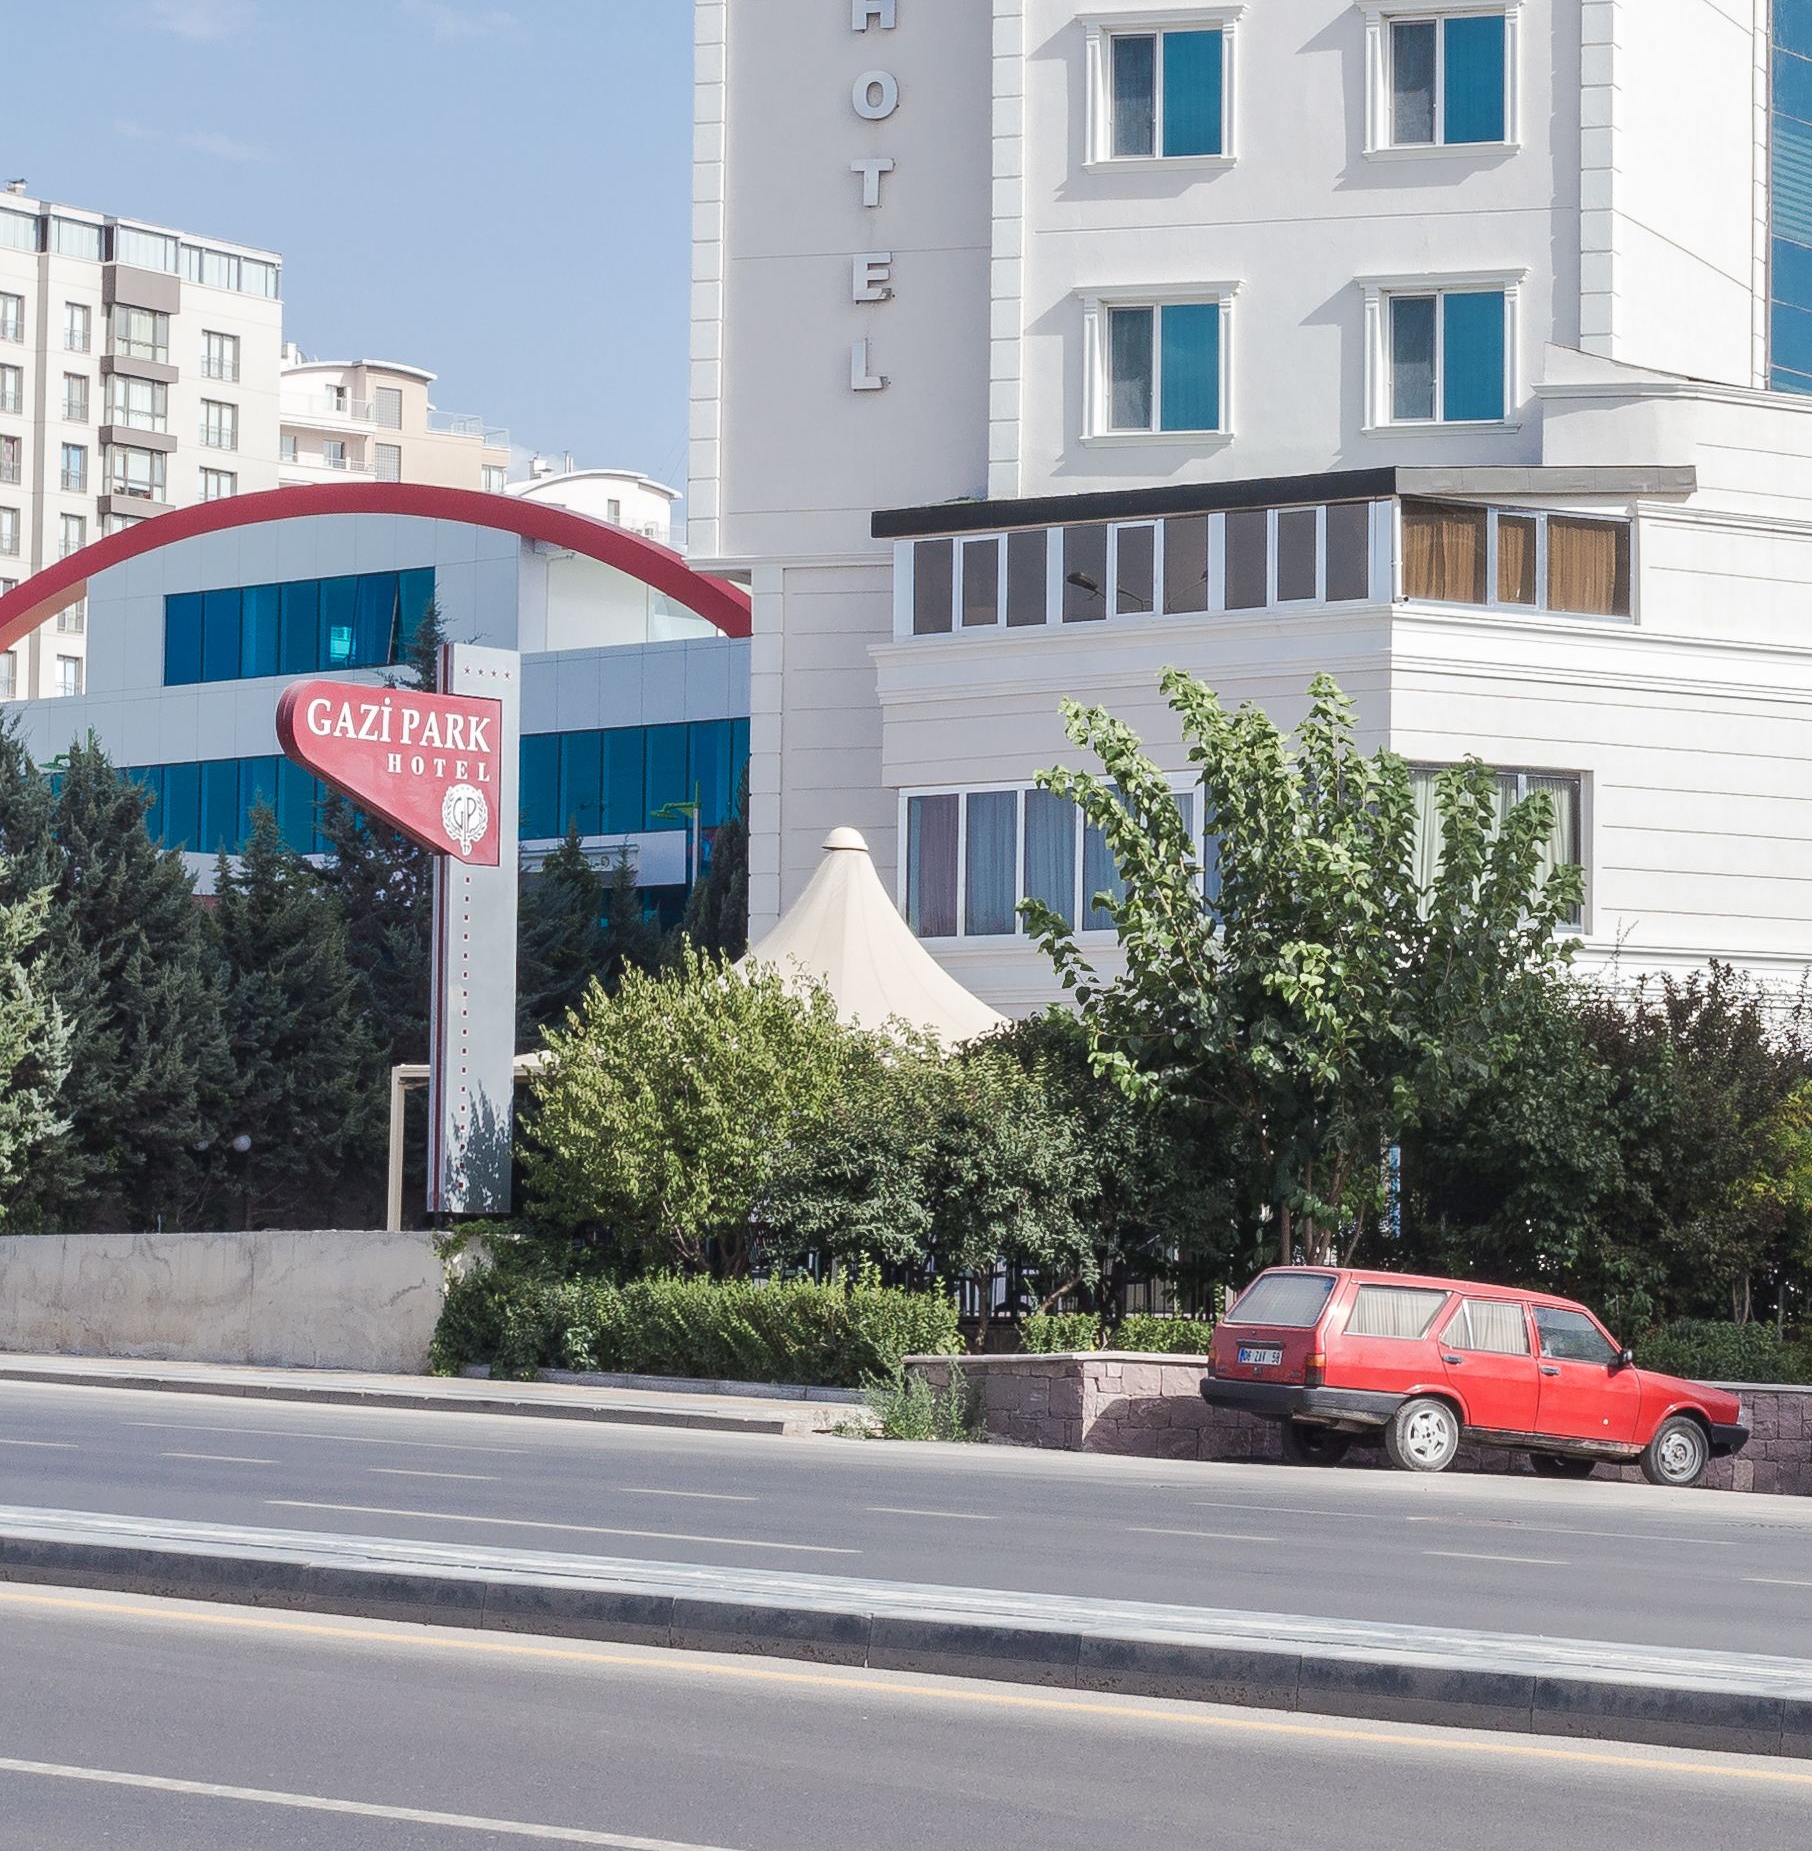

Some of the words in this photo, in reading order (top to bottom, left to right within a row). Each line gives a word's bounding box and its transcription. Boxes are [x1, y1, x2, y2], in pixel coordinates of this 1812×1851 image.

[307, 697, 393, 743] GAZİ
[399, 708, 491, 753] PARK
[387, 752, 490, 782] HOTEL
